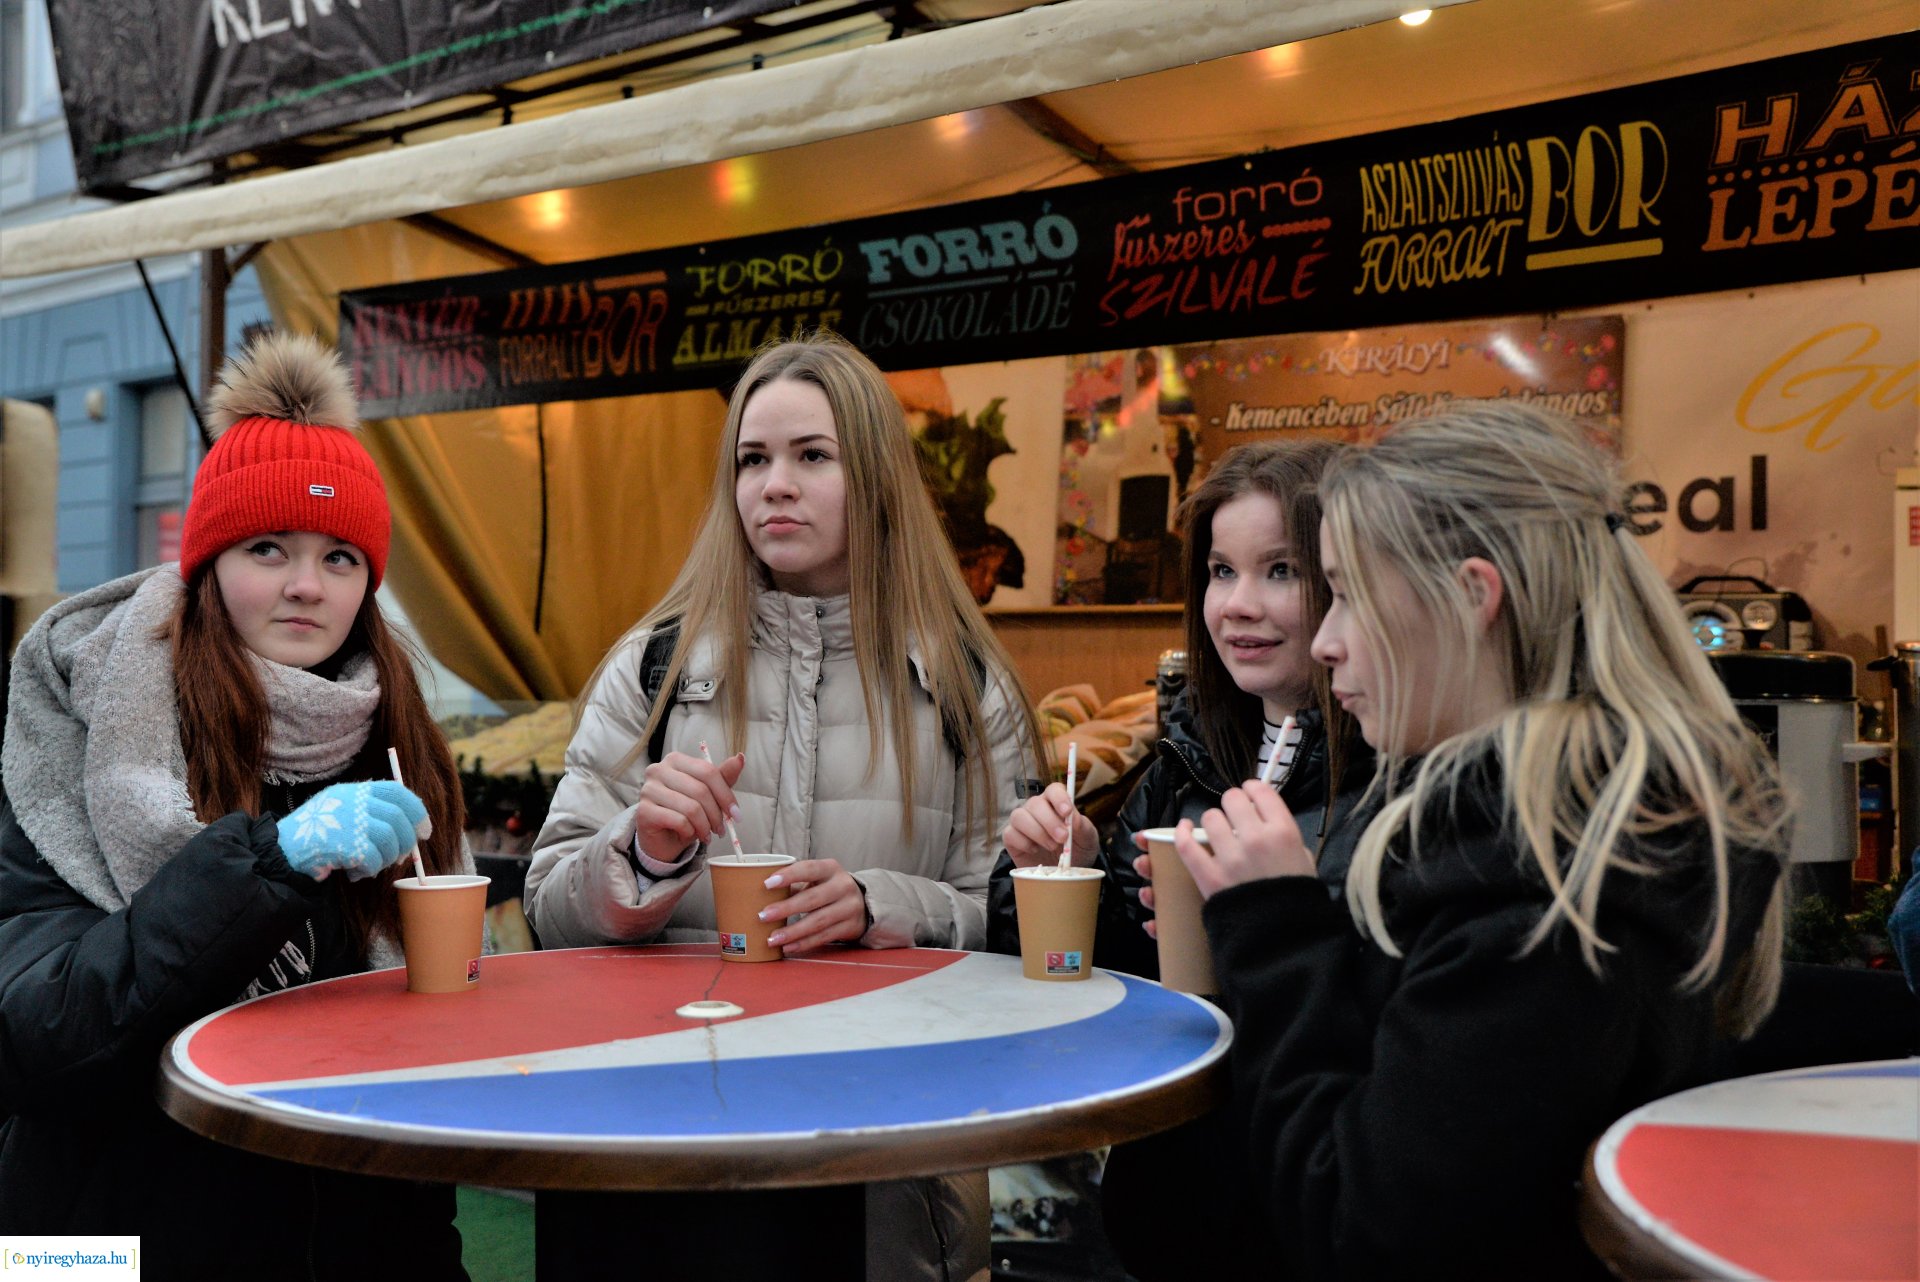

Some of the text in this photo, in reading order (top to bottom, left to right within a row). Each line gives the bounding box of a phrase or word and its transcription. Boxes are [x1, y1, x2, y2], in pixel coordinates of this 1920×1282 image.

[1173, 169, 1323, 223] forró
[1358, 120, 1669, 242] ASZALTSZILVÁS BOR
[684, 236, 844, 299] FORRÓ
[860, 200, 1079, 284] FORRÓ
[1353, 218, 1525, 296] FORRALT
[860, 267, 1076, 350] CSOKOLÁDÉ
[1098, 239, 1331, 327] SZILVALÉ
[583, 288, 669, 379] BOR
[1320, 337, 1451, 377] KIRÁLYI
[1225, 396, 1369, 432] Kemencében
[1622, 455, 1767, 536] eal
